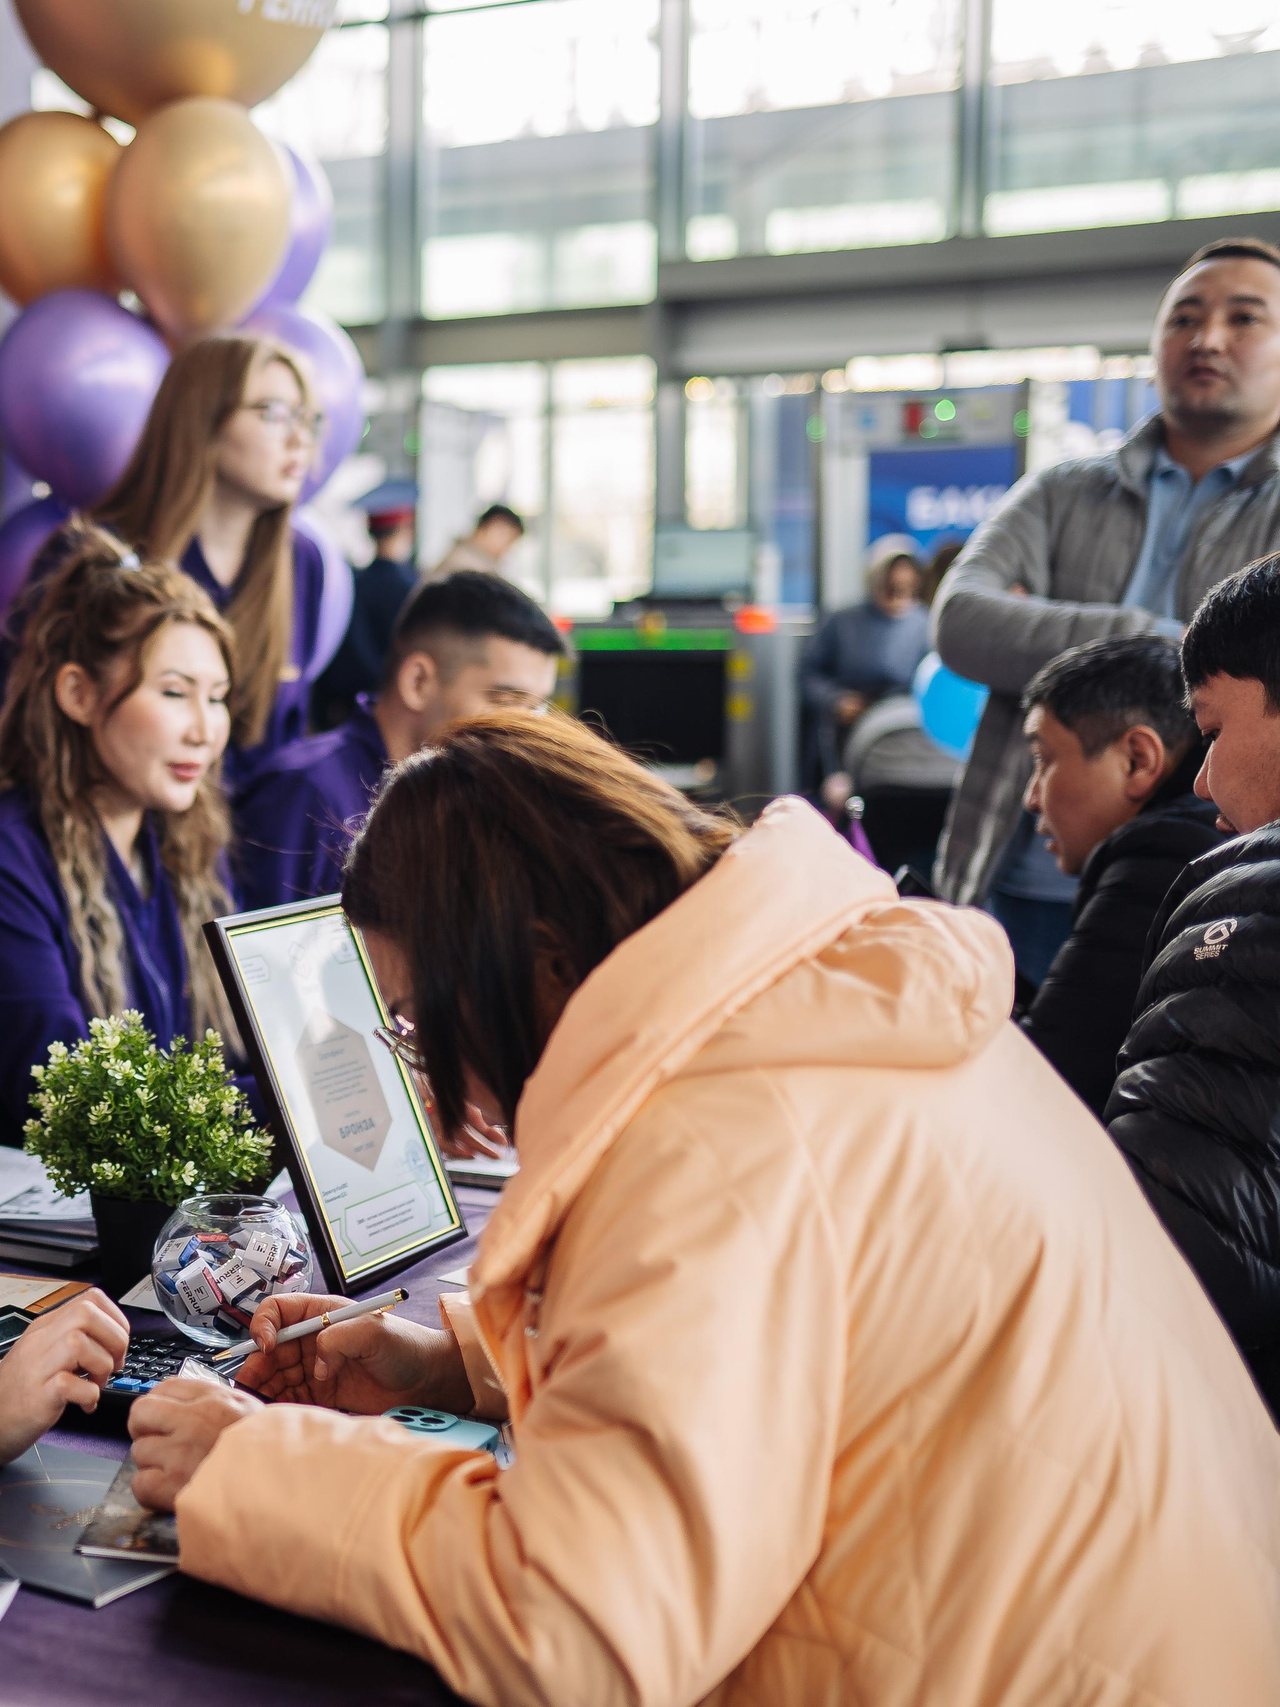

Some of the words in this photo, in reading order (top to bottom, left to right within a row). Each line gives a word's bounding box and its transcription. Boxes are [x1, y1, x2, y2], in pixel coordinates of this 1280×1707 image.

[1194, 944, 1228, 955] SUMMIT
[1195, 950, 1220, 961] SERIES
[339, 1117, 376, 1139] БРОНЗА
